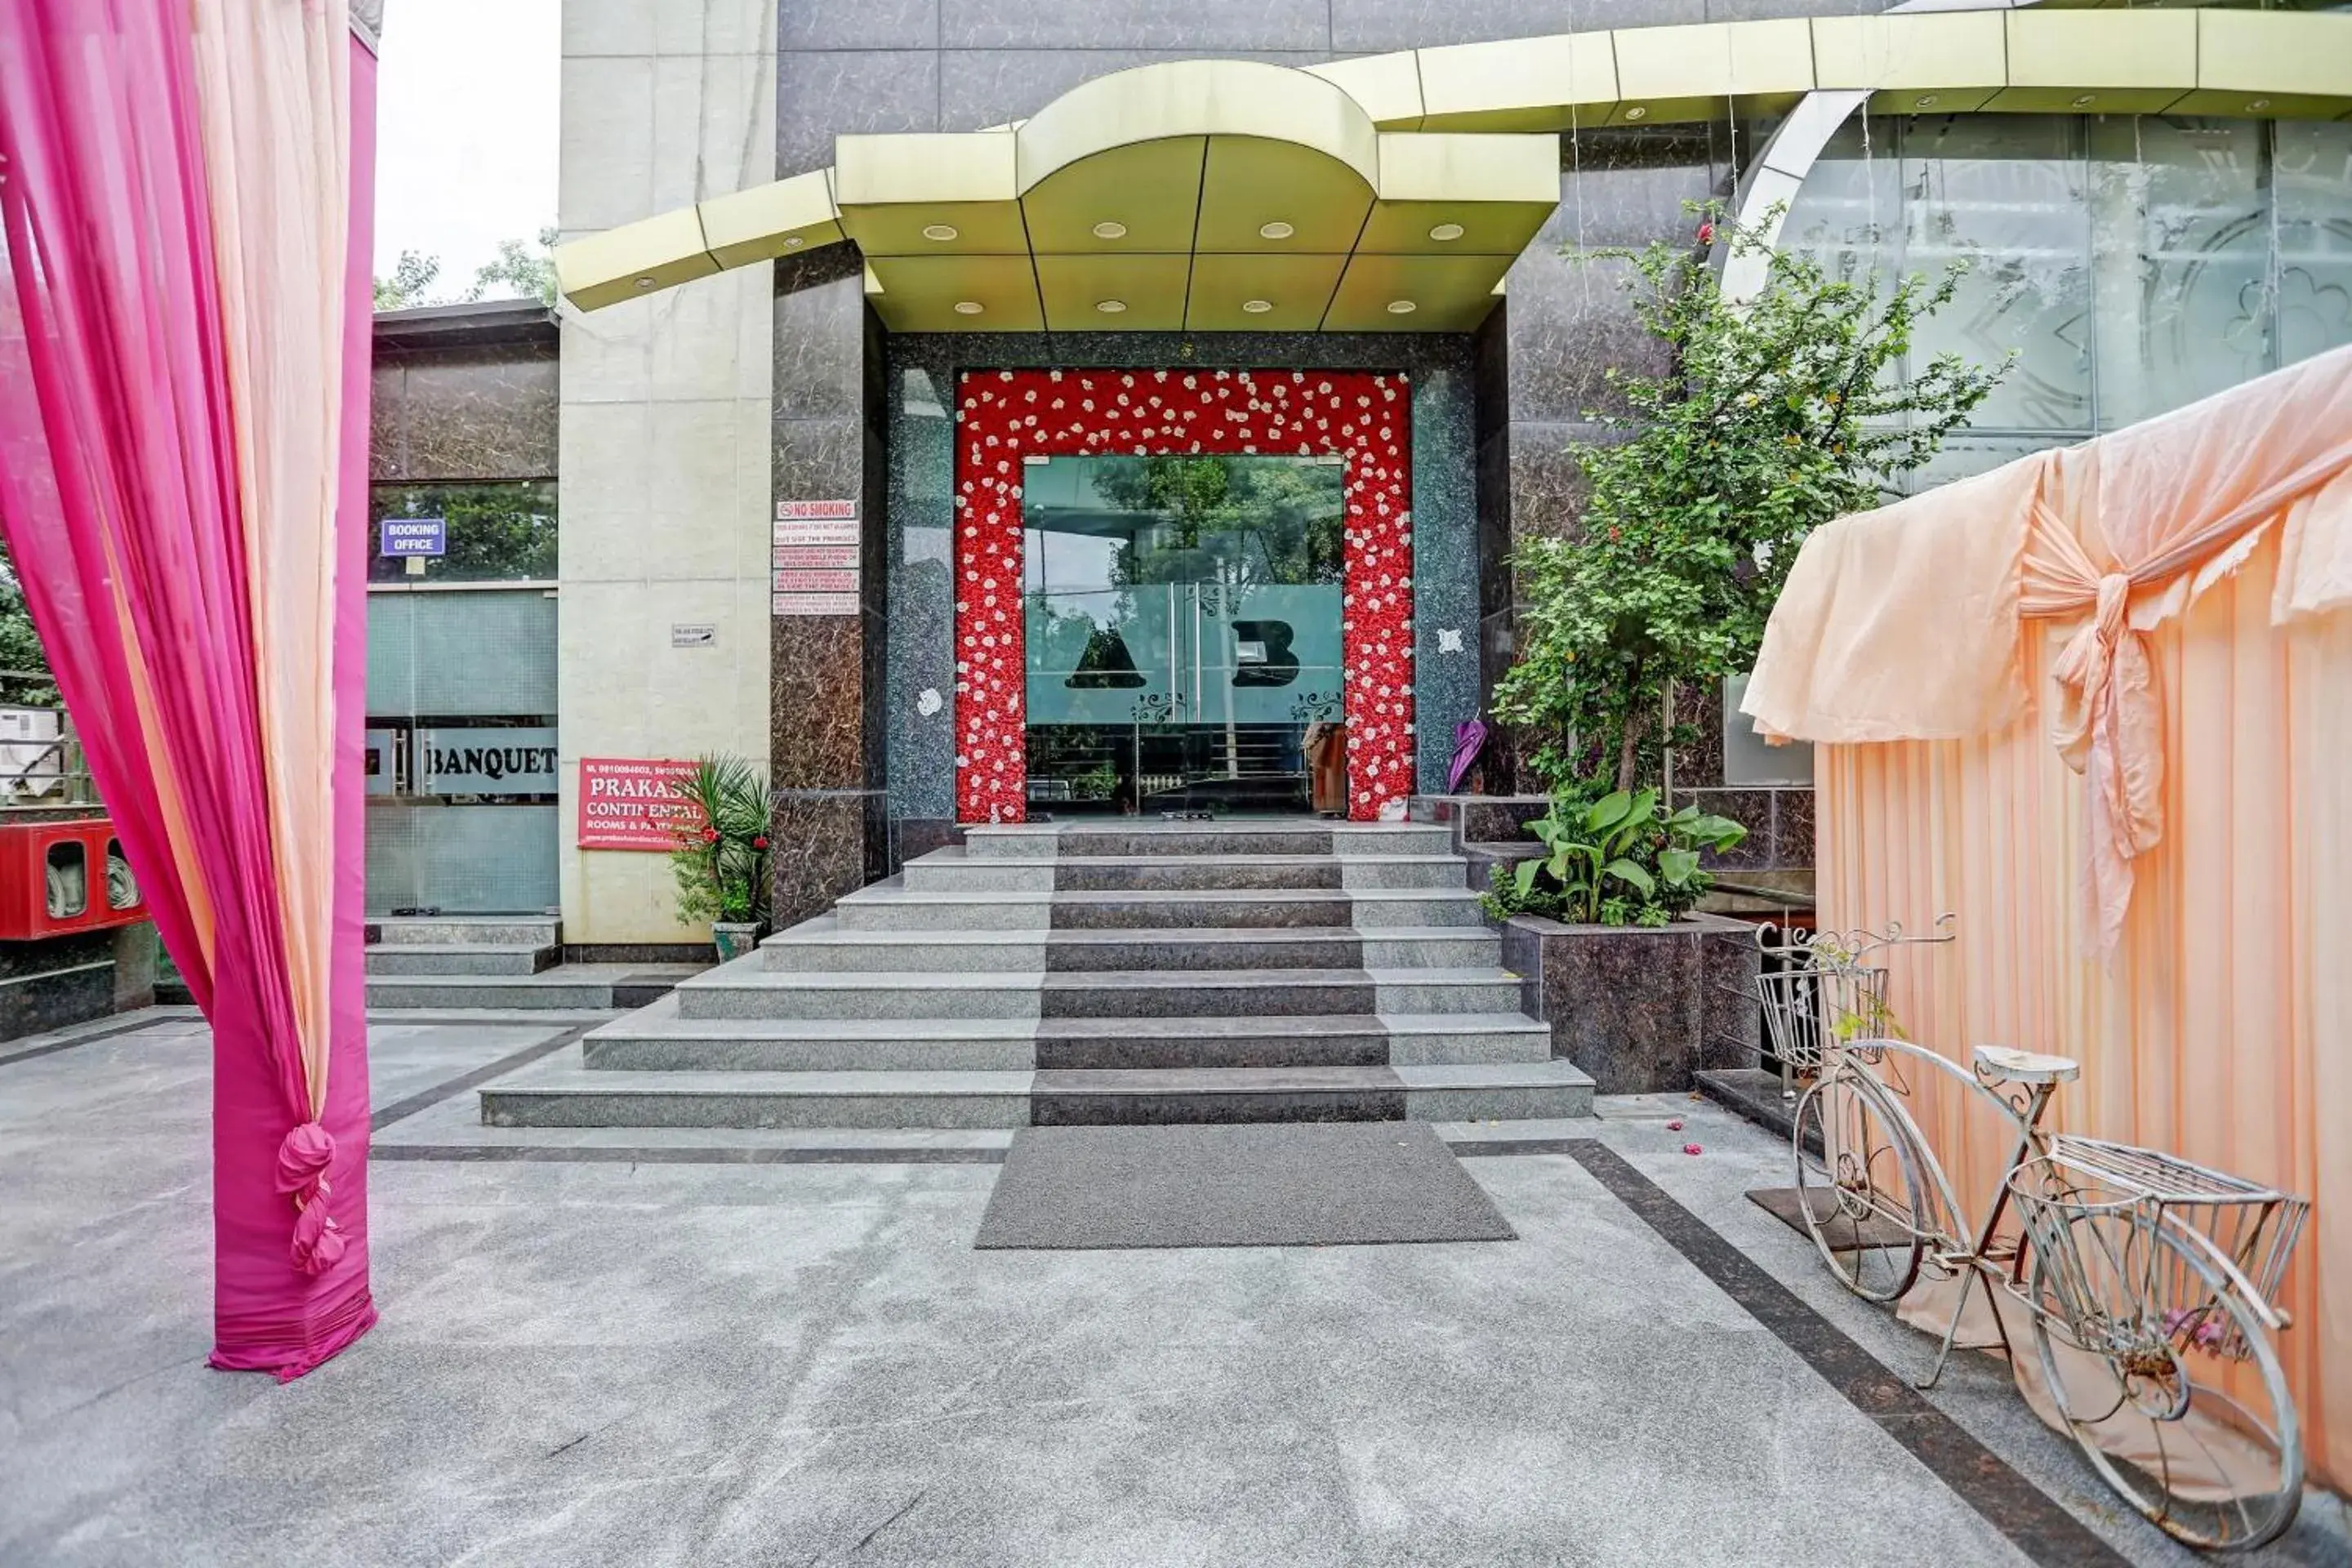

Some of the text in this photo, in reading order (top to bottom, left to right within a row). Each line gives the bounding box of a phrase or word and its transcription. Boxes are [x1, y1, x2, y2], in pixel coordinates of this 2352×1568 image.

[794, 502, 851, 516] NO SMOKING
[388, 524, 439, 536] BOOKING
[394, 539, 434, 550] OFFICE
[426, 747, 558, 780] BANQUET
[586, 820, 626, 830] ROOMS
[630, 822, 637, 830] &
